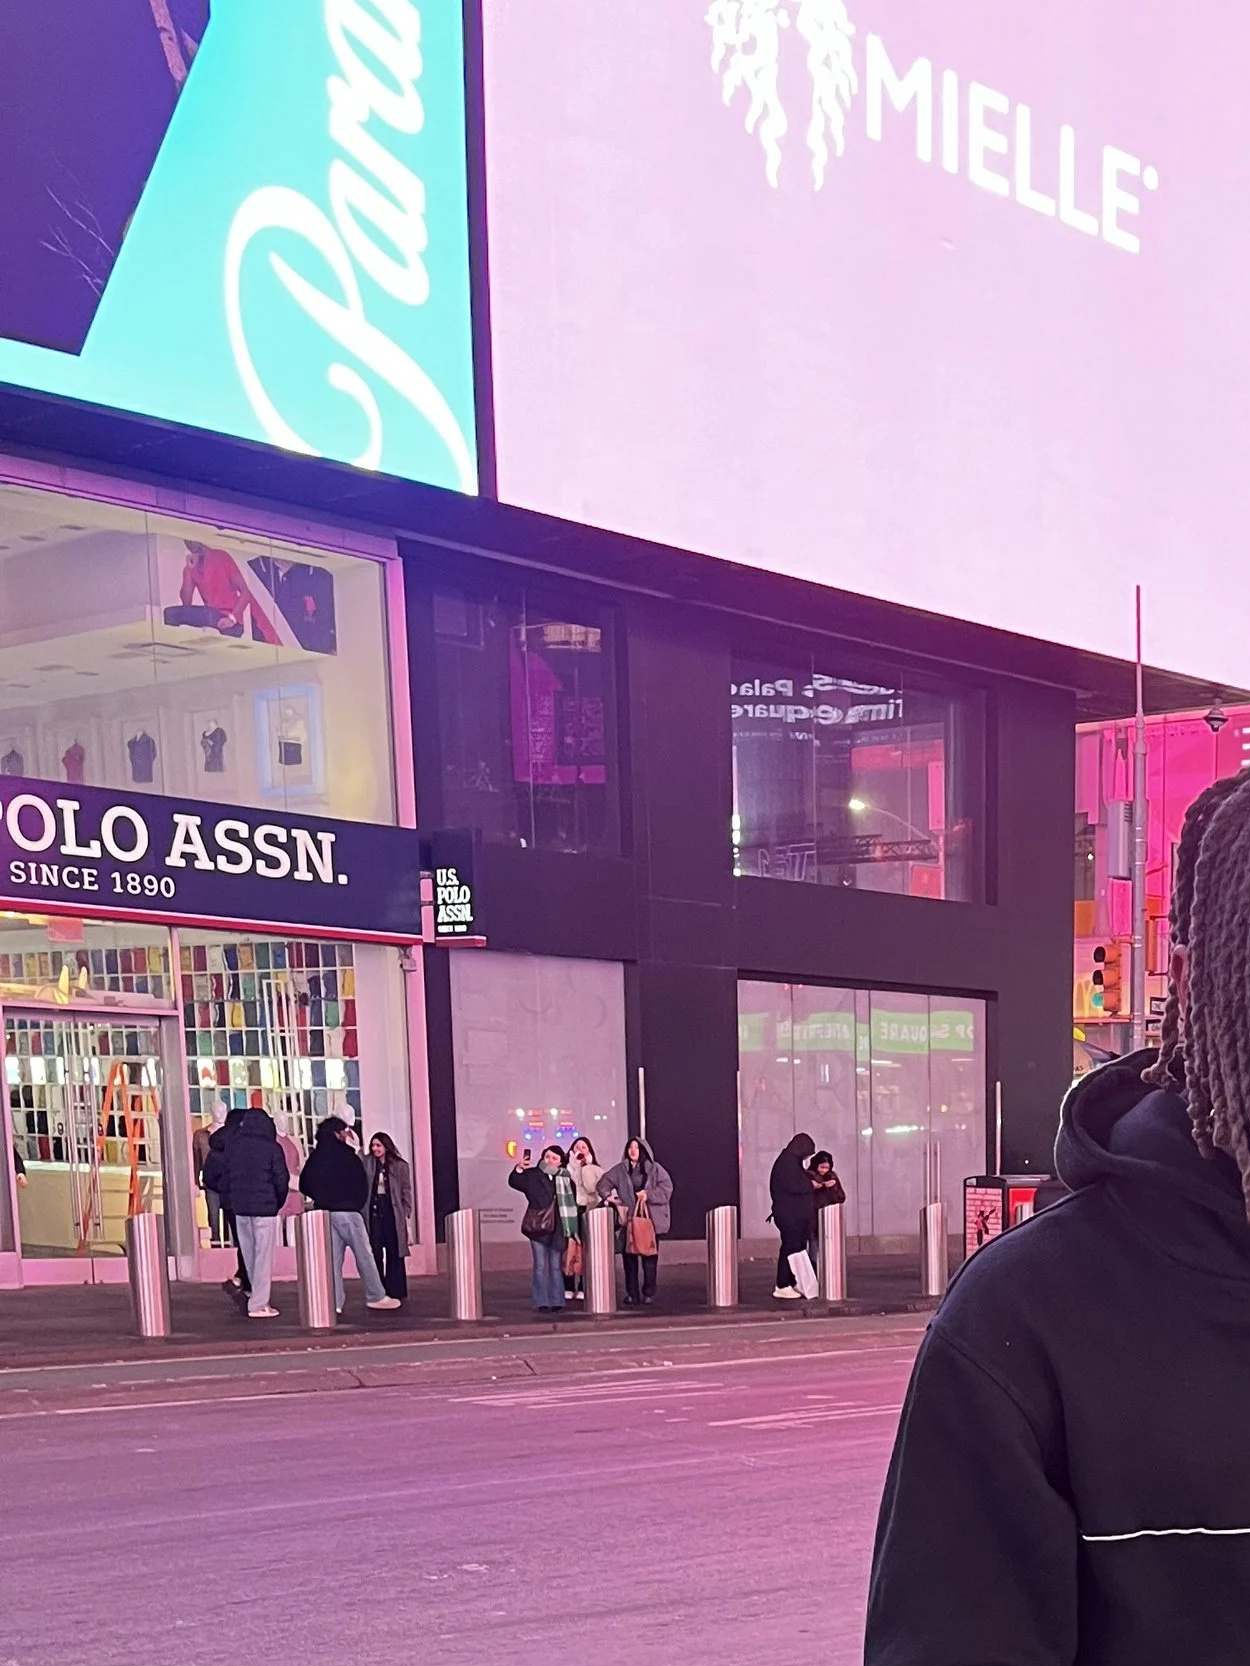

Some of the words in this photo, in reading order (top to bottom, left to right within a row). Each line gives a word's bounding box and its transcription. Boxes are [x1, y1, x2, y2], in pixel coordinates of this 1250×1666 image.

[865, 31, 1159, 254] MIELLE
[0, 793, 149, 863] OLO
[165, 813, 349, 885] ASSN.
[9, 861, 99, 891] SINCE
[111, 871, 176, 898] 1890
[436, 868, 460, 886] U.S.
[436, 885, 471, 905] POLO
[437, 903, 474, 923] ASSN.
